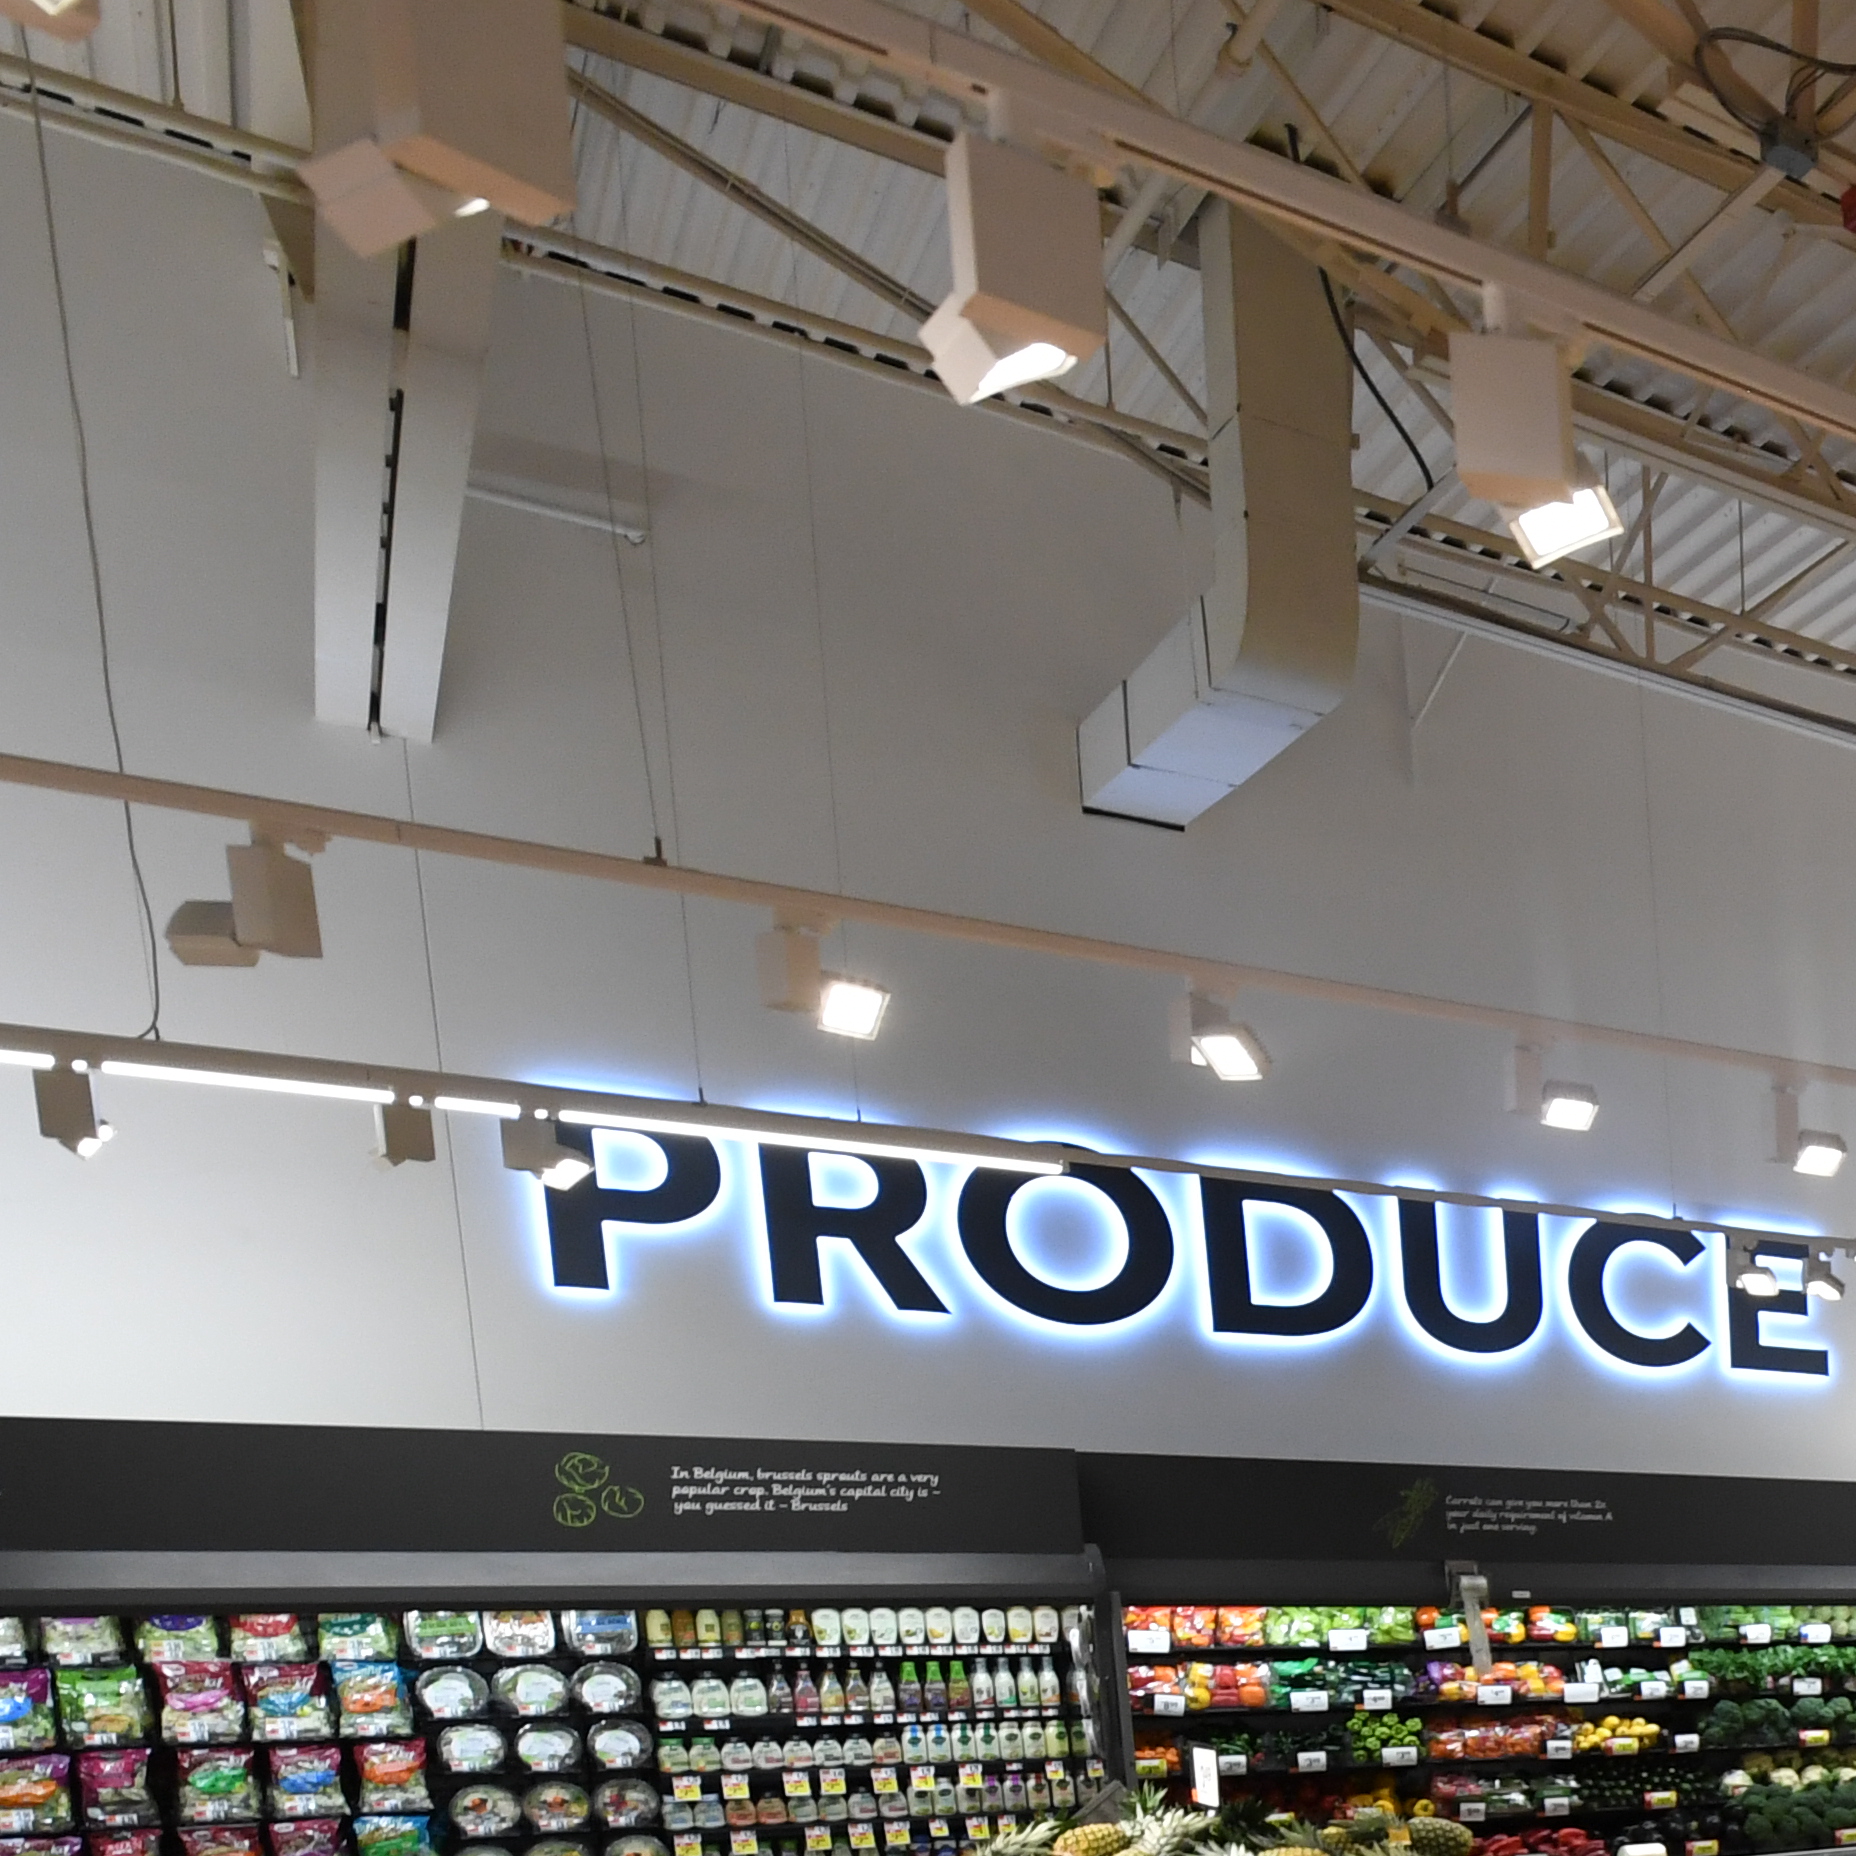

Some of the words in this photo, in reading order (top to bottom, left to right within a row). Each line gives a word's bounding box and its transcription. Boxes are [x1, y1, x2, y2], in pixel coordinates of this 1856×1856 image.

[545, 1114, 1829, 1376] PRODUCE
[671, 1467, 690, 1479] In
[692, 1467, 754, 1484] Belgium,
[757, 1468, 813, 1481] brussels
[816, 1470, 867, 1485] sprouts
[871, 1473, 895, 1482] are
[897, 1474, 907, 1482] a
[910, 1474, 939, 1487] very
[672, 1484, 729, 1499] popular
[733, 1485, 769, 1499] crop.
[771, 1484, 836, 1500] Belgium's
[840, 1485, 886, 1500] capital
[890, 1487, 914, 1501] city
[917, 1487, 928, 1498] is
[674, 1502, 701, 1515] you
[705, 1500, 761, 1515] guessed
[764, 1499, 776, 1511] it
[790, 1499, 848, 1512] Brussels
